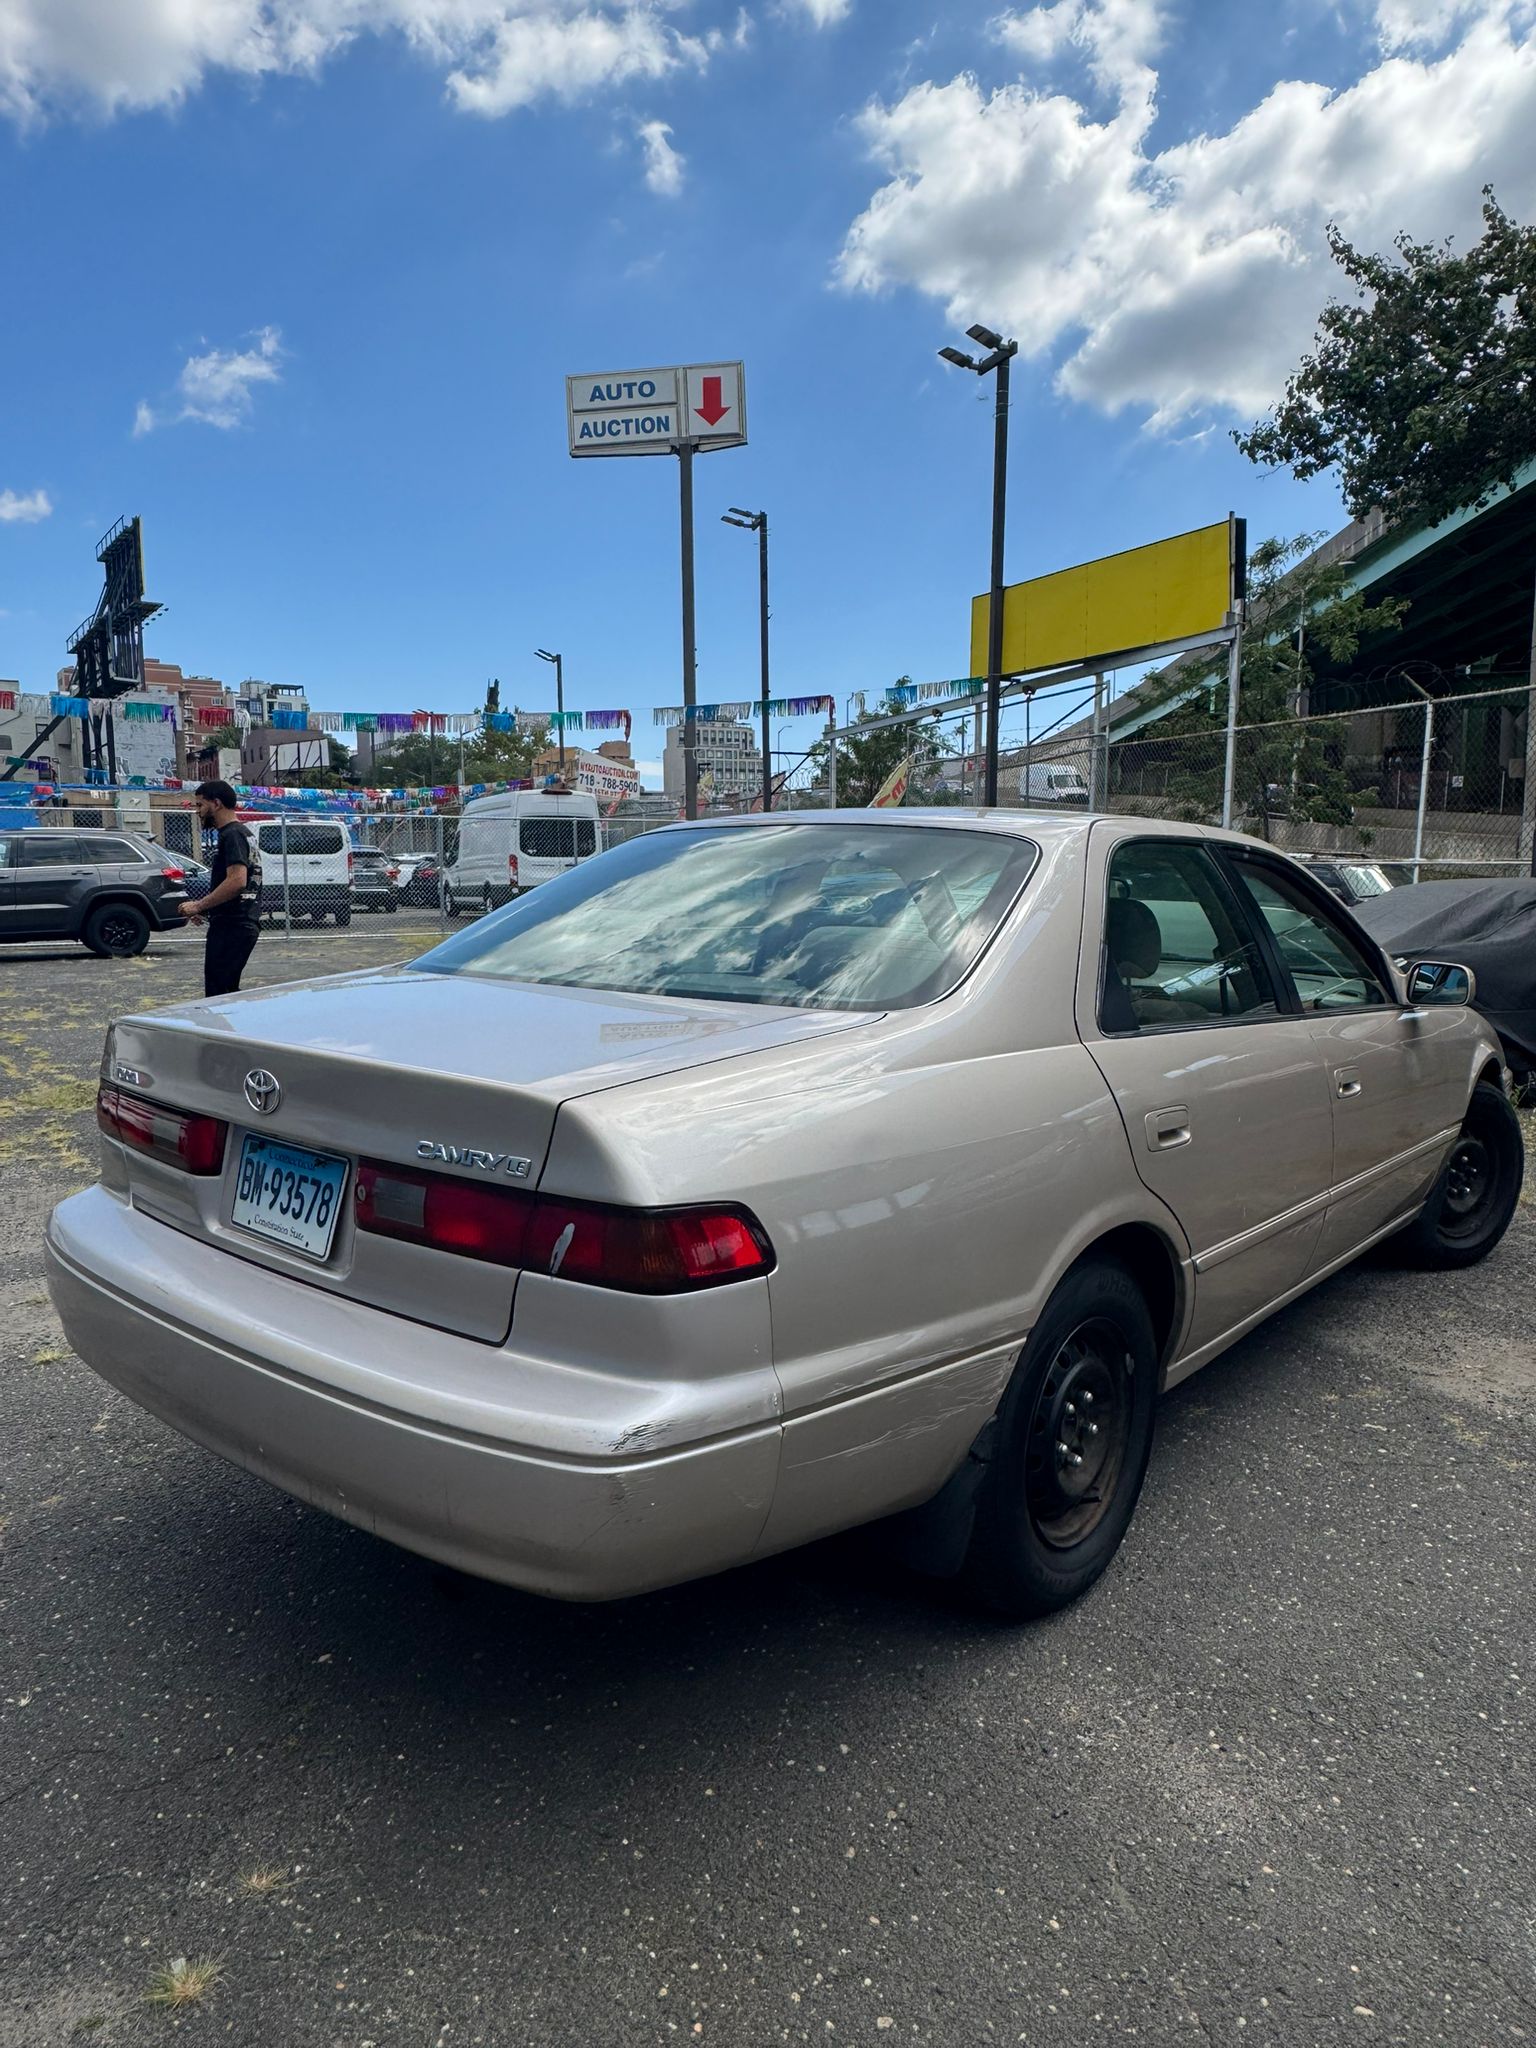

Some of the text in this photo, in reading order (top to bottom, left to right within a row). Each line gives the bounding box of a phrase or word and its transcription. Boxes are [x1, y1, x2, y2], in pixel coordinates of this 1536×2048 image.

[589, 380, 656, 402] AUTO
[579, 415, 670, 439] AUCTION
[579, 773, 595, 787] 718
[416, 1140, 528, 1177] CAMRY LE
